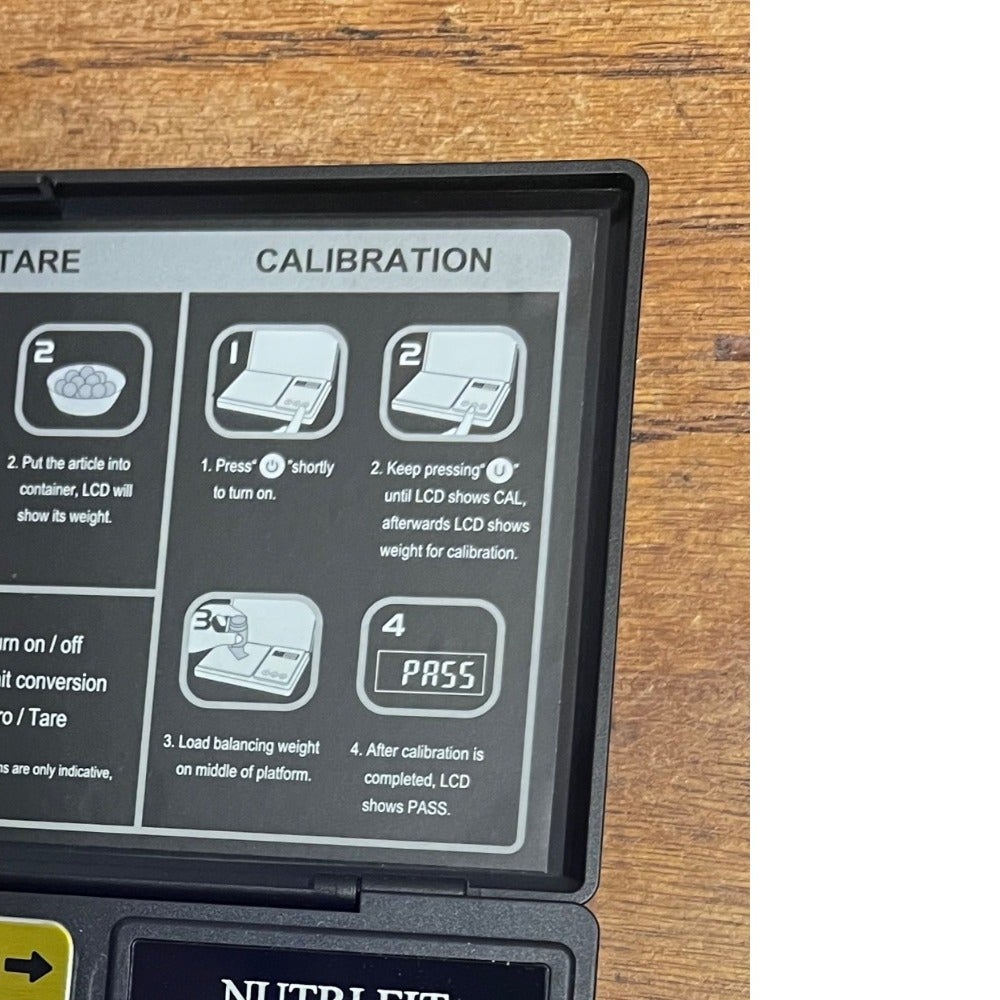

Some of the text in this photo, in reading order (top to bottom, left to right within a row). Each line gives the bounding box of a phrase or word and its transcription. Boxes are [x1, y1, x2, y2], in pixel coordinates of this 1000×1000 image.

[256, 248, 492, 272] CALIBRATION
[34, 339, 55, 363] 2
[399, 343, 421, 365] 2
[22, 456, 43, 470] Put
[46, 457, 65, 470] the
[68, 458, 105, 470] article
[108, 459, 130, 471] into
[387, 462, 422, 479] Keep
[19, 483, 133, 499] container, LCD will
[213, 486, 276, 500] to turn on.
[384, 489, 527, 507] until LCD shows CAL,
[17, 508, 112, 527] show its weight.
[382, 516, 530, 532] afterwards LCD shows
[380, 544, 518, 561] weight for calibration.
[382, 613, 405, 637] 4
[24, 636, 46, 652] on
[60, 635, 84, 654] off
[15, 671, 107, 692] conversion
[402, 659, 475, 689] PASS
[29, 708, 67, 727] Tare
[178, 735, 210, 749] Load
[213, 737, 275, 755] balancing
[278, 739, 320, 756] weight
[366, 743, 399, 758] After
[402, 744, 469, 760] calibration
[473, 747, 484, 761] is
[12, 763, 30, 774] are
[32, 763, 56, 778] only
[58, 765, 112, 780] indicative,
[176, 764, 312, 783] on middle of platform.
[364, 772, 469, 790] completed, LCD
[362, 799, 450, 815] shows PASS.
